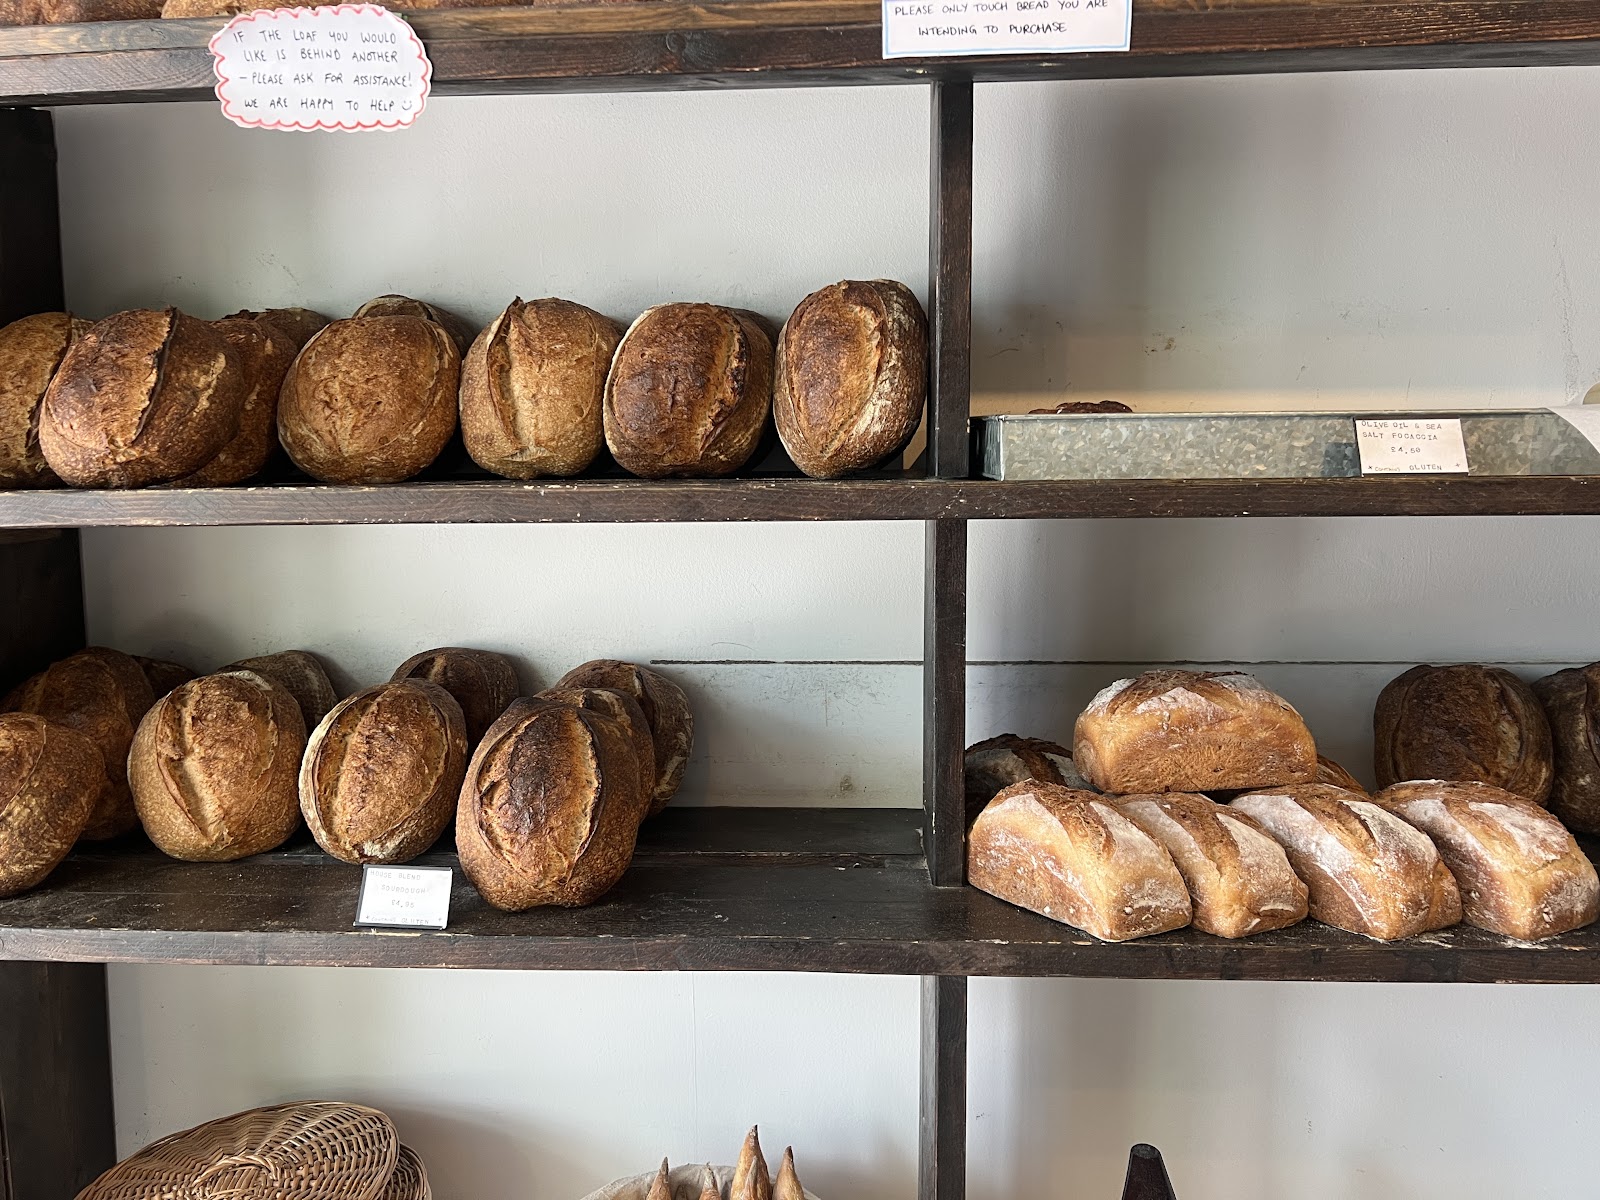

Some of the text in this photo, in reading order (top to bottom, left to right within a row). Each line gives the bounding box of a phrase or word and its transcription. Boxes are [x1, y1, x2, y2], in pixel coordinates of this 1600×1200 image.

[895, 0, 1108, 17] PLEASE ONLY TOUCH BREAD YOU ARE
[918, 21, 1068, 36] INTENDING TO PURCHASE
[233, 30, 397, 45] IF THE LOAF YOU WOULD
[243, 48, 398, 64] LIKE IS BEHIND ANOTHER
[293, 72, 314, 84] ASK
[324, 72, 344, 84] FOR
[353, 71, 413, 88] ASSISTANCE!
[244, 98, 395, 112] WE ARE HAPPY TO HELP
[1361, 420, 1389, 429] OLIVE
[1392, 421, 1409, 430] OIL
[1362, 431, 1438, 441] SALT FOCACCIA
[1408, 463, 1443, 471] GLUTEN
[370, 870, 421, 880] HOUSE BLEND
[381, 884, 426, 894] SOURDOUGH
